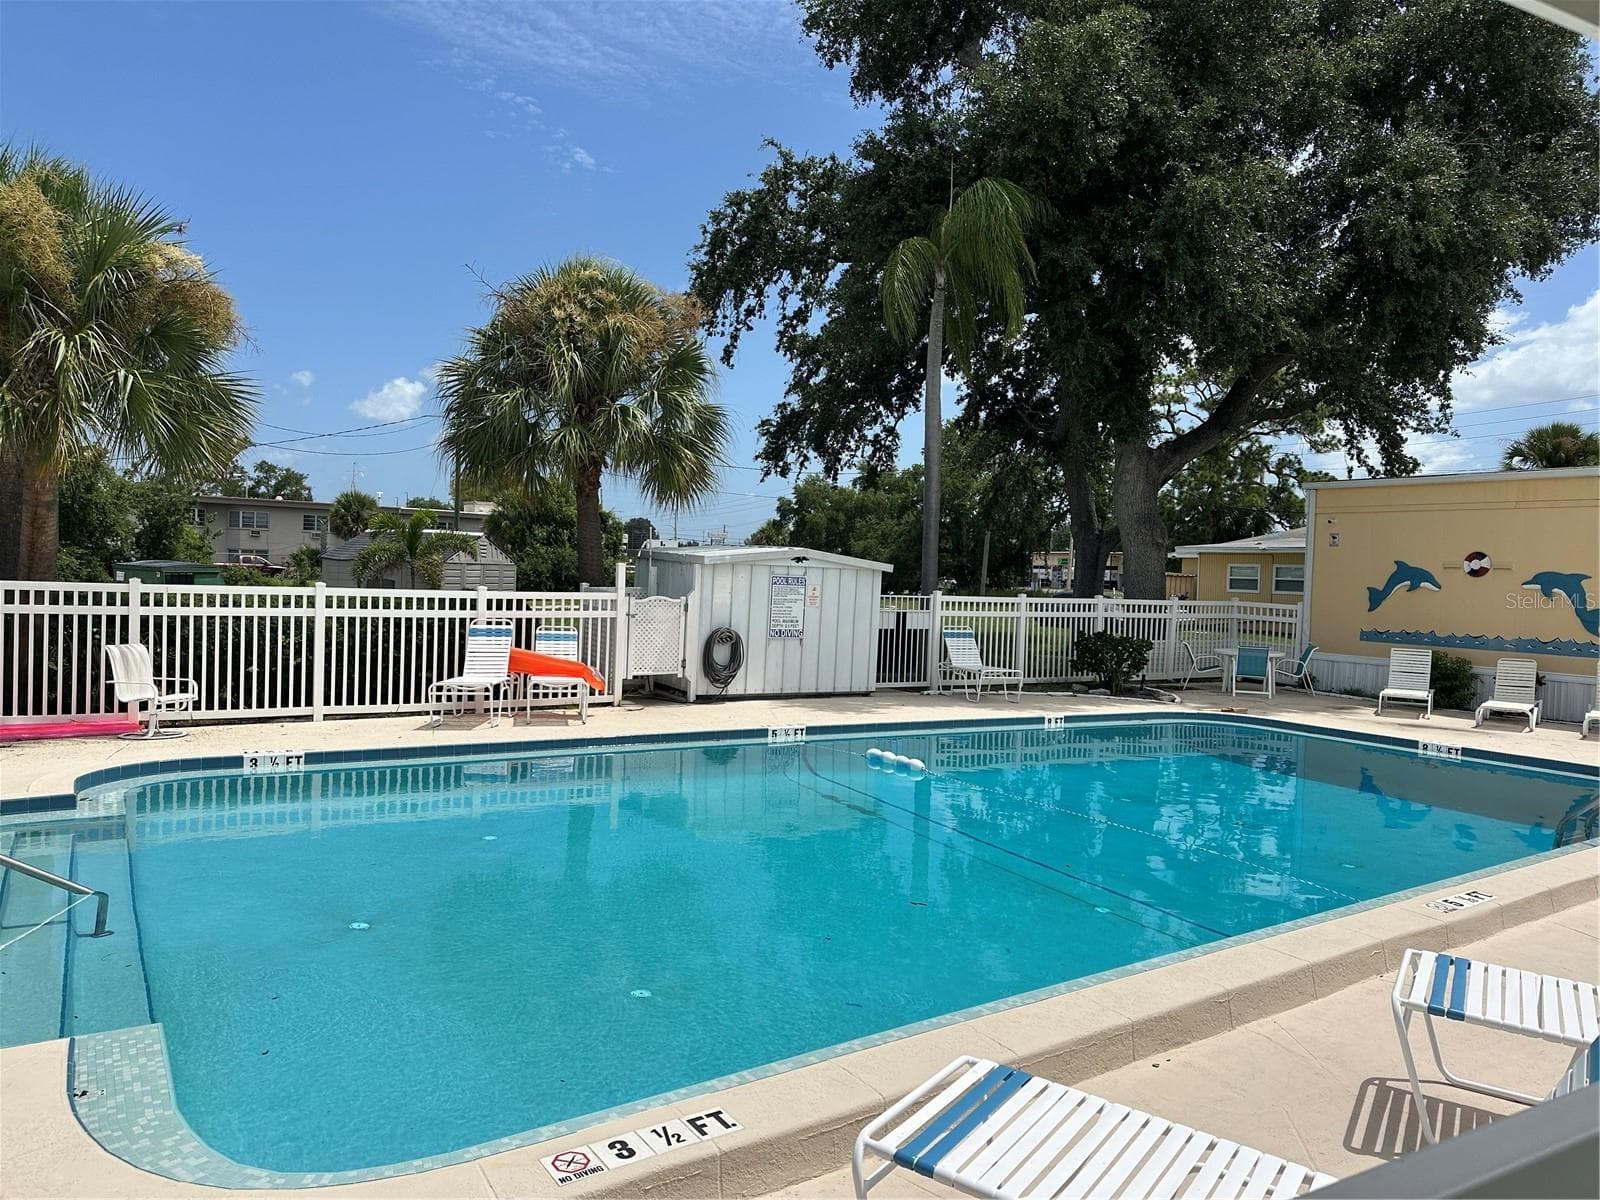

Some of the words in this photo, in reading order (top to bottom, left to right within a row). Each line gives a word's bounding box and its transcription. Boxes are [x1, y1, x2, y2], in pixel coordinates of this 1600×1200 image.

[772, 576, 787, 585] POOL
[787, 577, 805, 586] RULES
[769, 629, 780, 637] NO
[780, 629, 804, 638] DIVING
[771, 729, 778, 738] 5
[794, 728, 804, 737] FT
[1447, 747, 1460, 756] FT
[249, 757, 258, 768] 3
[286, 755, 303, 766] FT
[607, 1140, 636, 1160] 3
[686, 1110, 737, 1137] FT.
[558, 1175, 573, 1184] NO
[573, 1165, 605, 1180] DIVING
